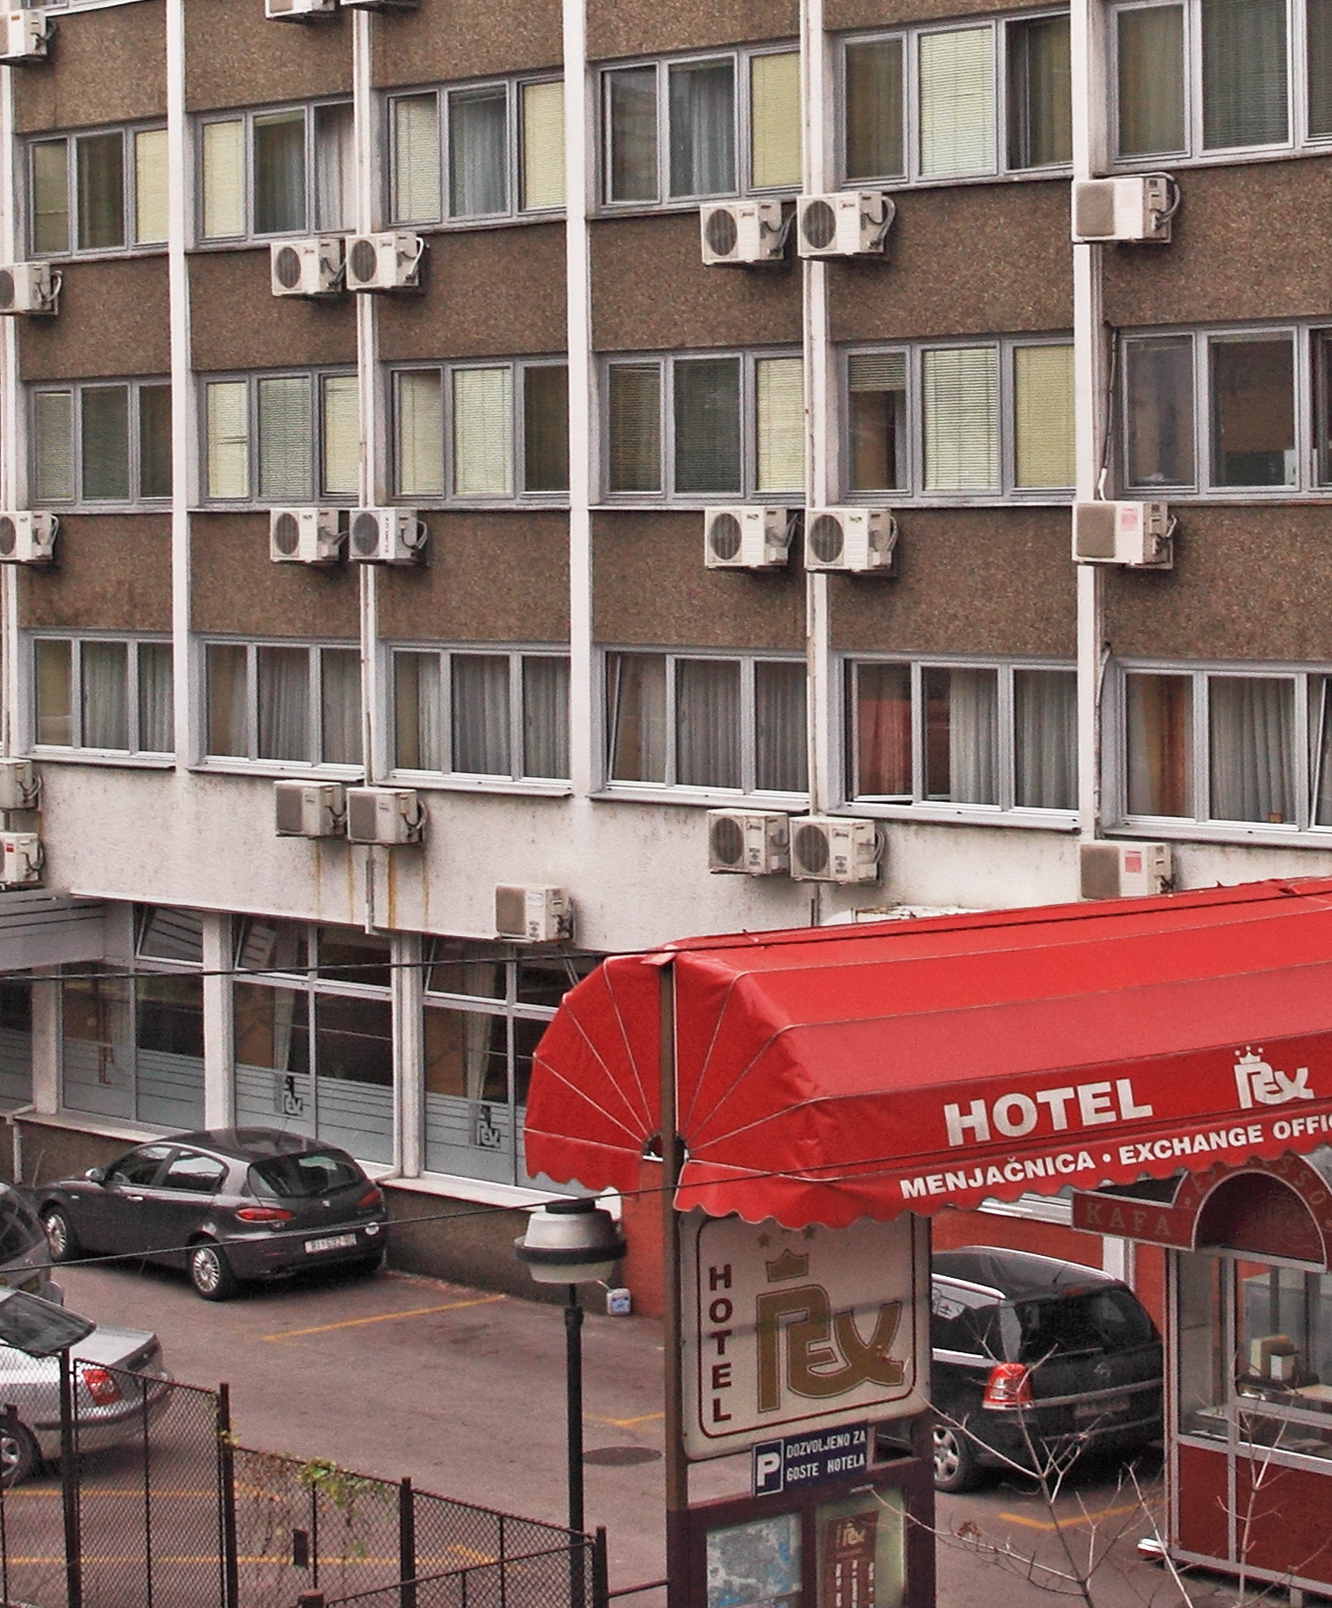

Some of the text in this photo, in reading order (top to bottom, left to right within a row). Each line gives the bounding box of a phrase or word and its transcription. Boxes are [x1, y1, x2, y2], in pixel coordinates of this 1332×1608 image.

[943, 1078, 1153, 1146] HOTEL
[900, 1151, 1095, 1198] MENJAČNICA
[1119, 1124, 1264, 1166] EXCHANGE
[1085, 1201, 1172, 1237] KAFA
[709, 1264, 733, 1422] HOTEL
[786, 1430, 866, 1458] DOZVOLJENO ZA
[757, 1452, 780, 1487] P
[786, 1453, 866, 1481] GOSTE HOTELA
